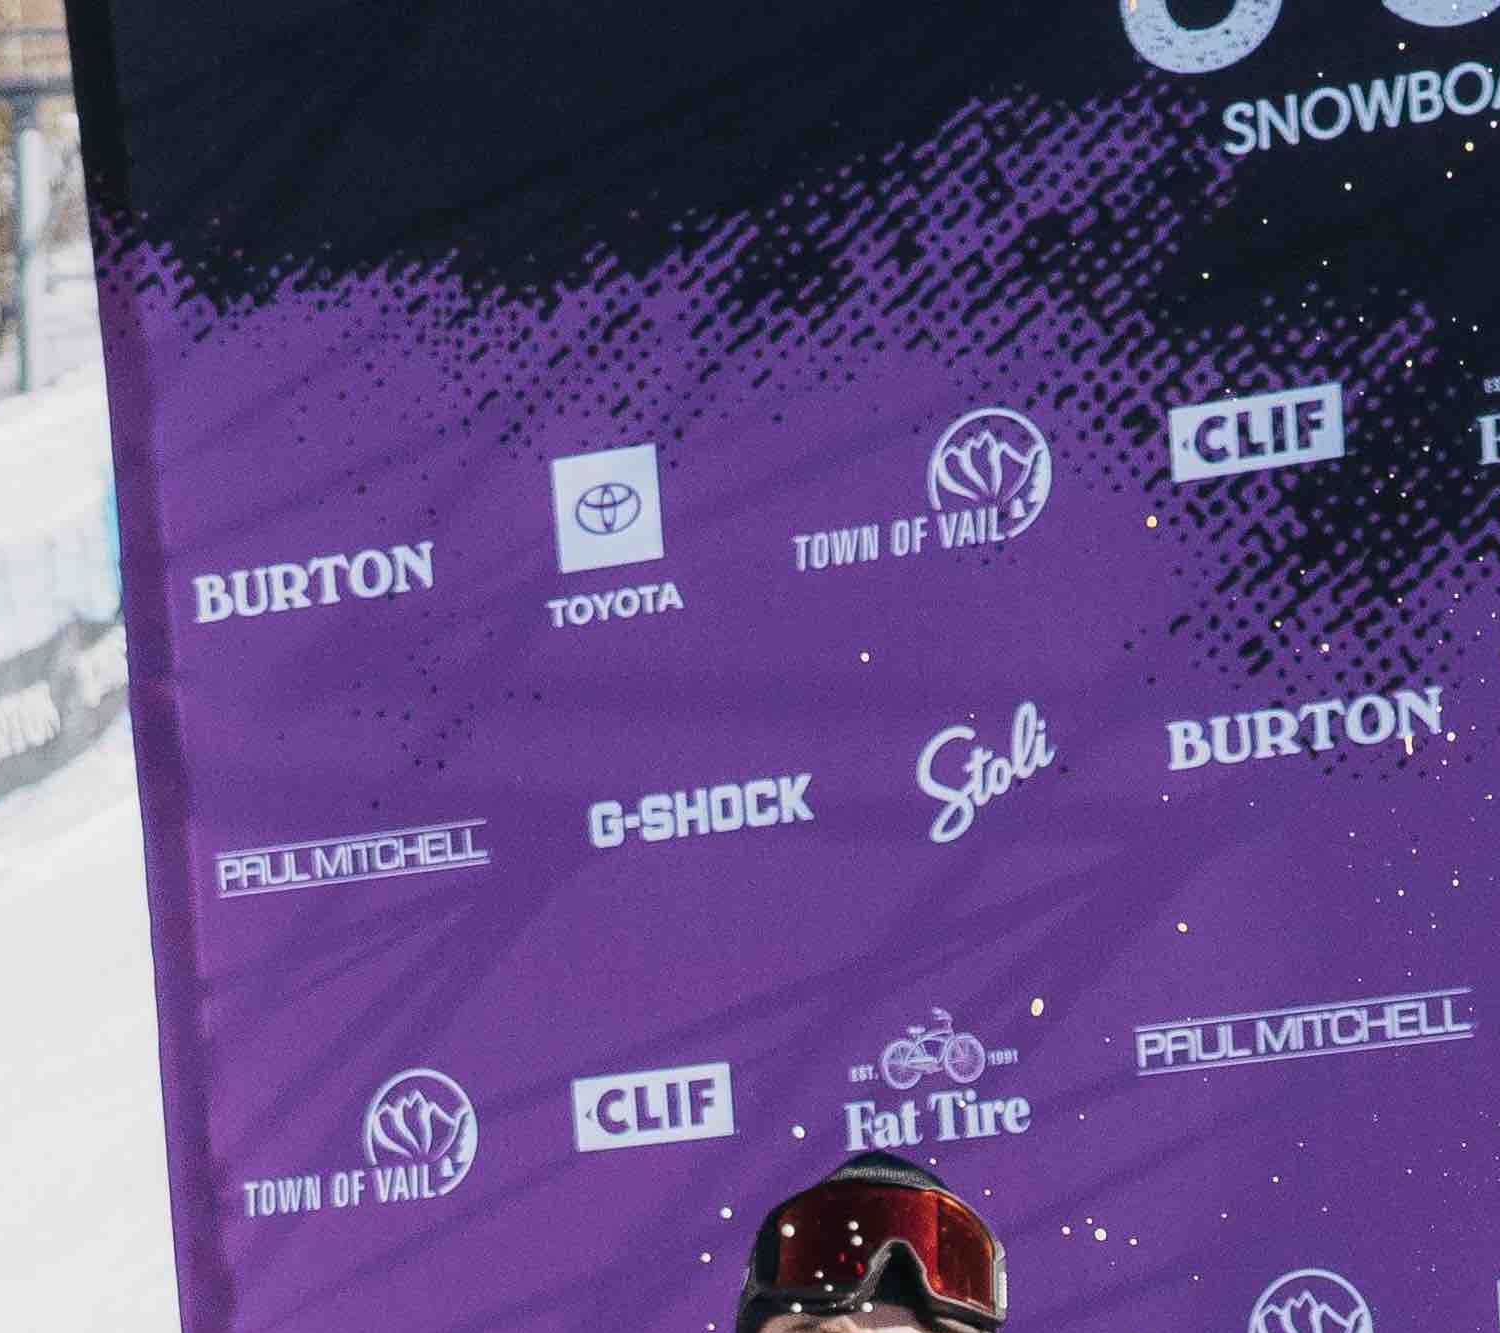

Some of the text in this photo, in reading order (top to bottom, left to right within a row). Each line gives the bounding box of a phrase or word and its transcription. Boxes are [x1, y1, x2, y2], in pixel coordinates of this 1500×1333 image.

[1192, 398, 1329, 464] CLIF
[792, 506, 1006, 571] TOWN OF VAIL
[192, 541, 434, 624] BURTON
[547, 582, 684, 628] TOYOTA
[1164, 685, 1443, 771] BURTON
[915, 701, 1055, 843] Stoli
[589, 773, 814, 849] G-SHOCK
[217, 827, 488, 893] PAUL MITCHELL
[1136, 998, 1473, 1069] PAUL MITCHELL
[593, 1079, 719, 1136] CLIF
[843, 1090, 1030, 1152] Fat Tire
[243, 1159, 438, 1218] TOWN OF VAIL
